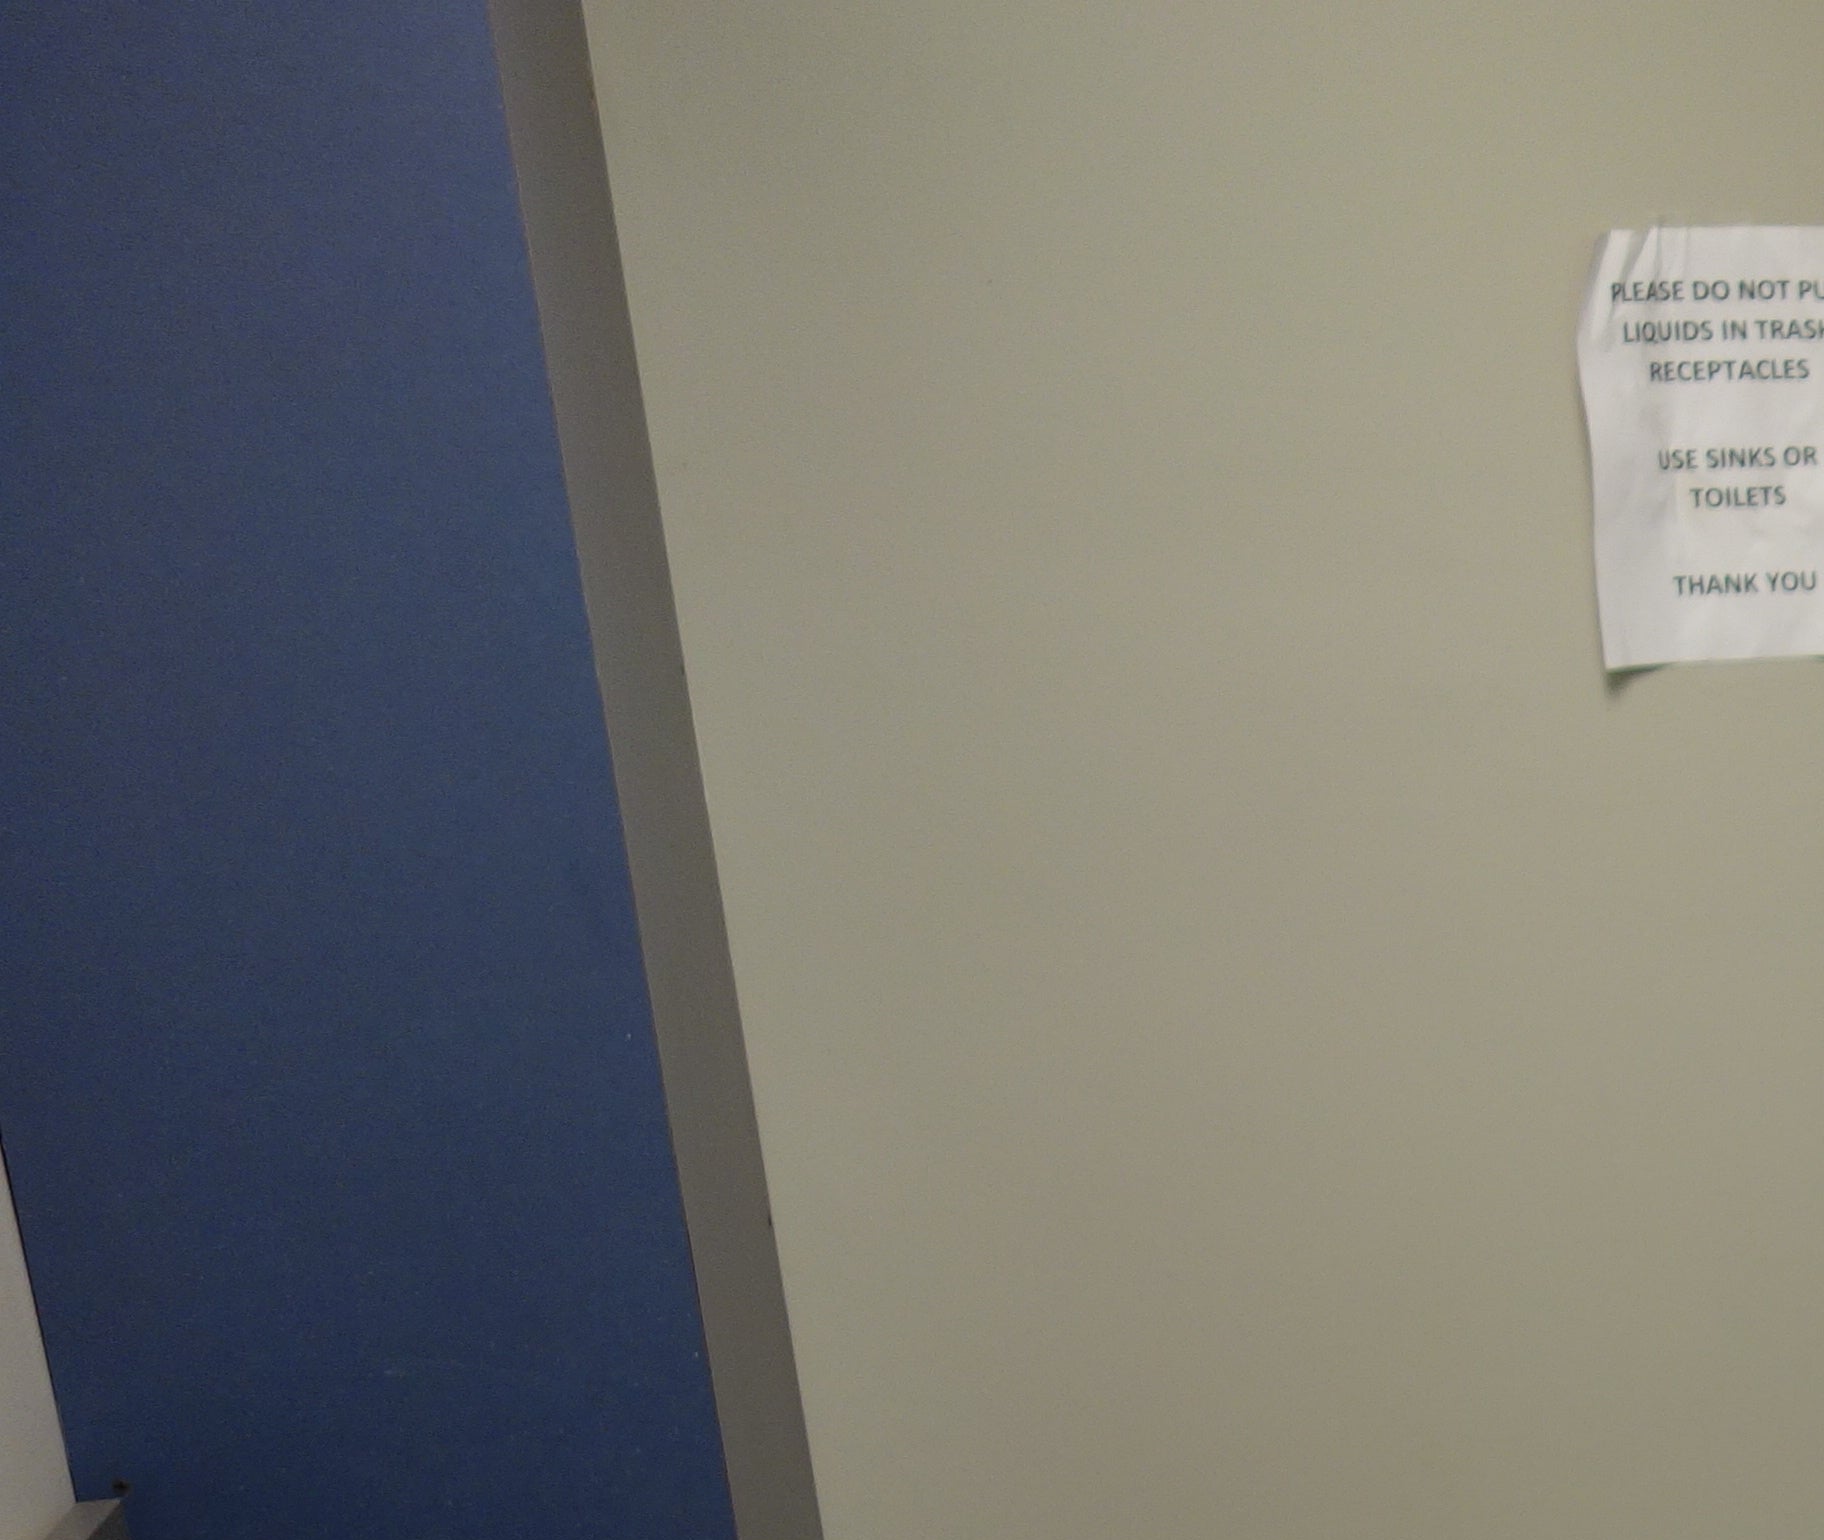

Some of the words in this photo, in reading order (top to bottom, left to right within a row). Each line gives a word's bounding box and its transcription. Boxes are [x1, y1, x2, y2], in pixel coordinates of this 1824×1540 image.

[1610, 281, 1685, 302] PLEASE
[1692, 280, 1730, 300] DO
[1739, 280, 1790, 300] NOT
[1623, 320, 1713, 343] LIQUIDS
[1722, 319, 1747, 340] IN
[1650, 358, 1809, 381] RECEPTACLES
[1658, 449, 1698, 470] USE
[1706, 447, 1776, 468] SINKS
[1783, 446, 1818, 467] OR
[1690, 485, 1786, 507] TOILETS
[1673, 573, 1759, 595] THANK
[1766, 570, 1817, 592] YOU
